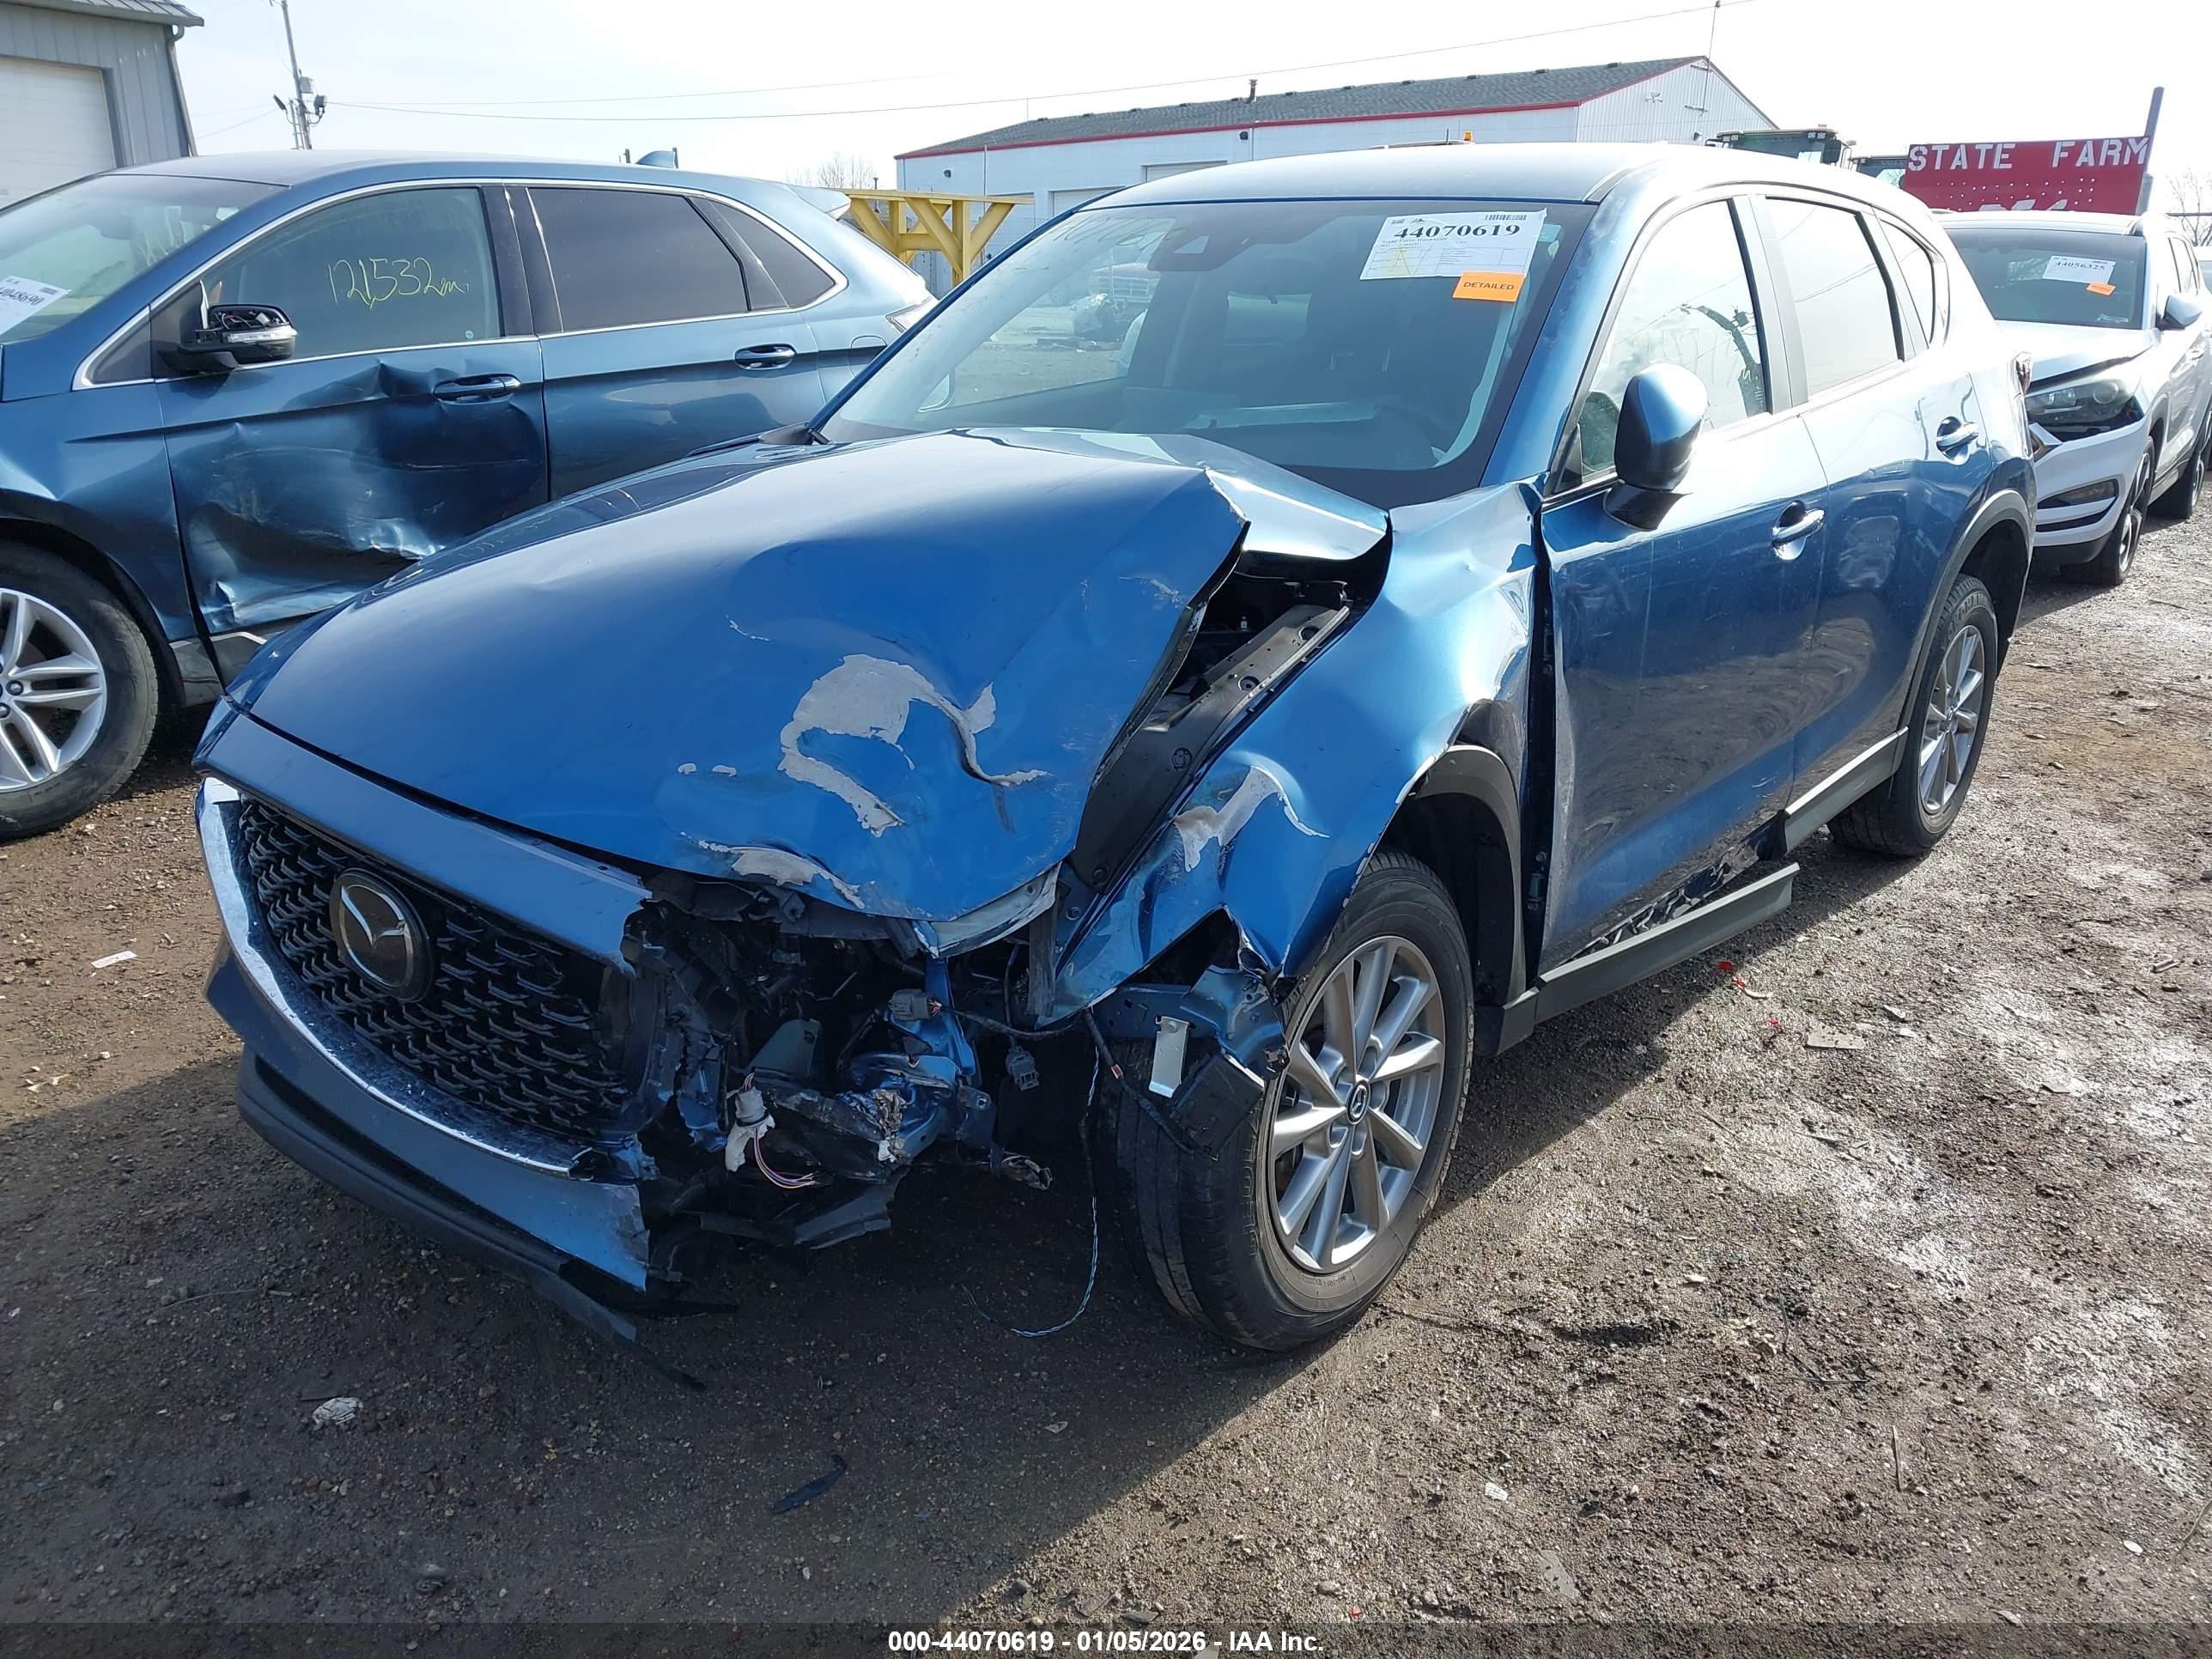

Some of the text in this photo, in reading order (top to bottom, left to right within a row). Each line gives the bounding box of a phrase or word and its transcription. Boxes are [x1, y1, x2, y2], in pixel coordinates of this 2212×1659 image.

[1908, 137, 2149, 172] STATE FARM
[1394, 224, 1521, 239] 44070619
[1463, 282, 1515, 290] DETAILED
